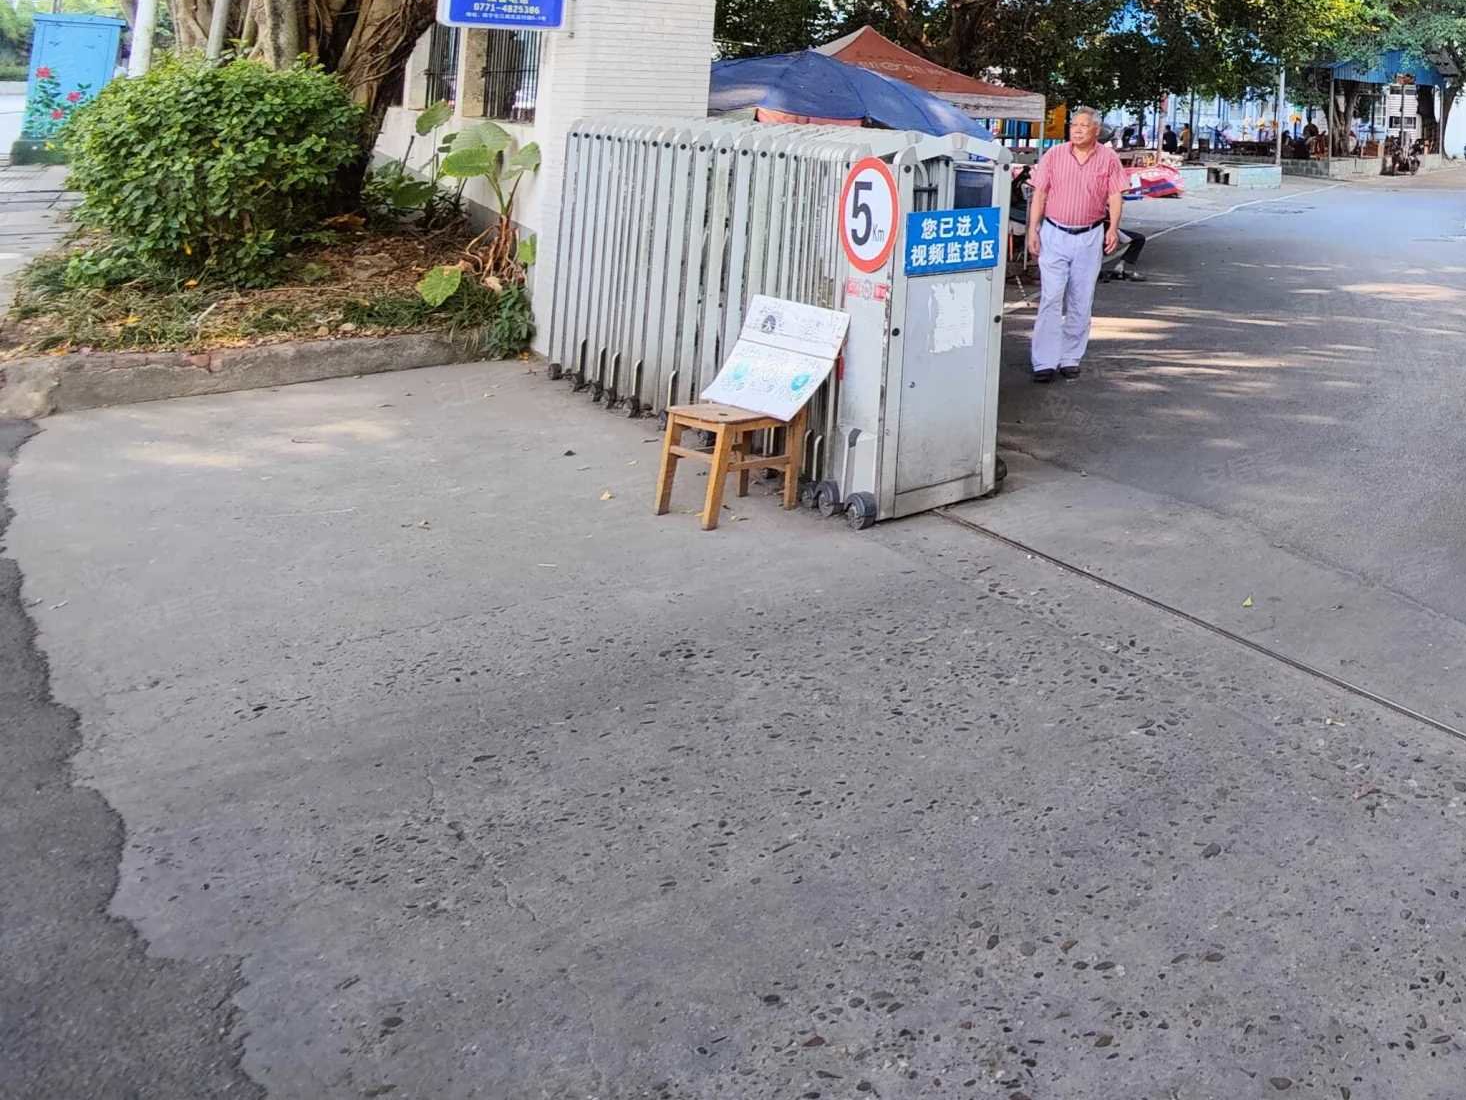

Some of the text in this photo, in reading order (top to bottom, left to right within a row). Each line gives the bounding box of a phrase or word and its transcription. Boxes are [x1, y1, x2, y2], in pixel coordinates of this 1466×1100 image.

[851, 181, 873, 246] 5
[920, 216, 988, 240] 您已进入
[910, 240, 995, 267] 视频监控区
